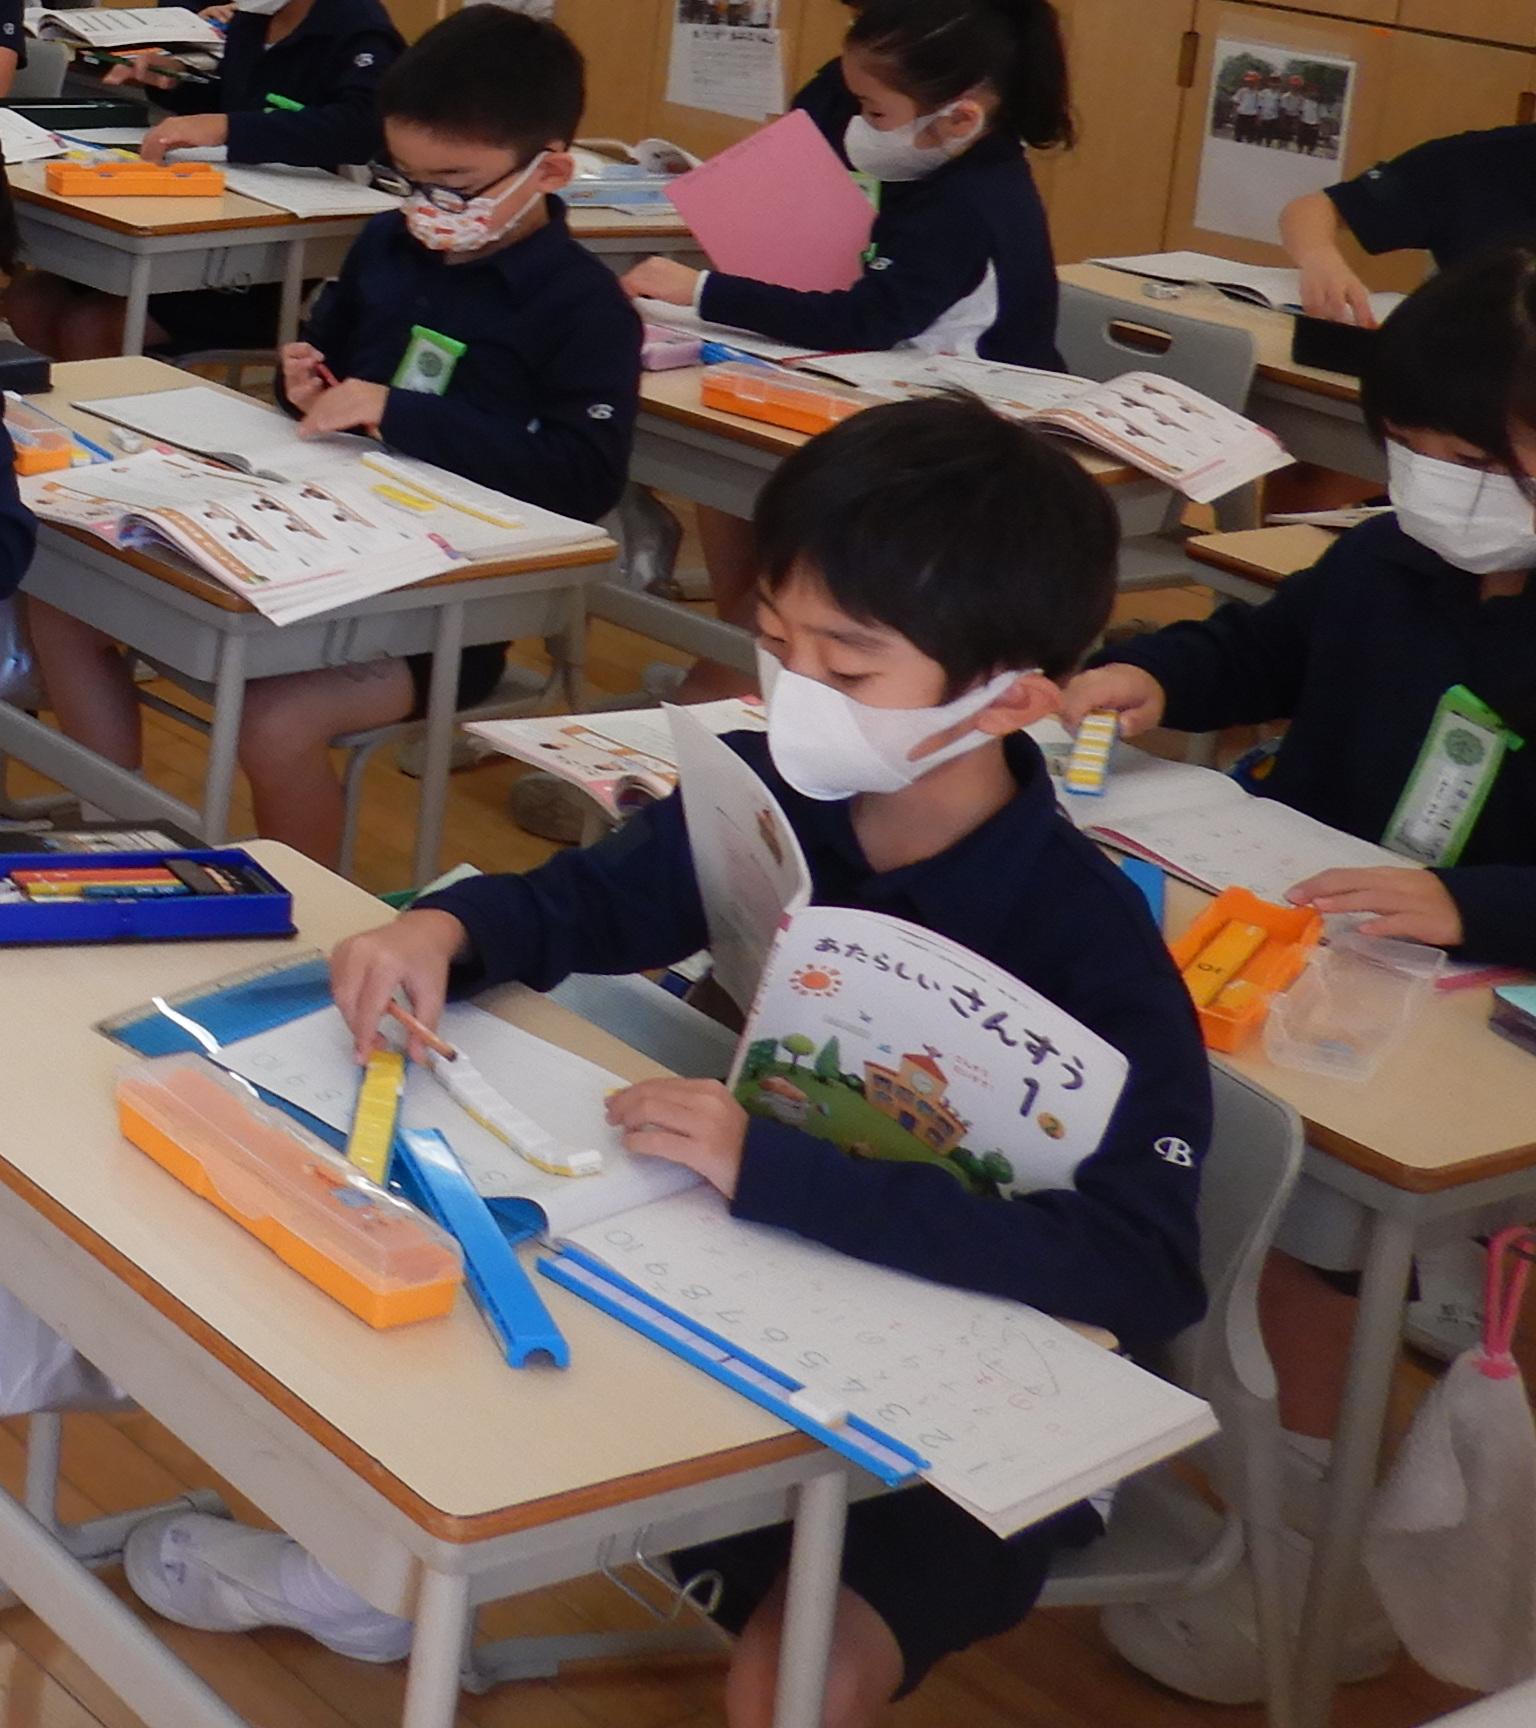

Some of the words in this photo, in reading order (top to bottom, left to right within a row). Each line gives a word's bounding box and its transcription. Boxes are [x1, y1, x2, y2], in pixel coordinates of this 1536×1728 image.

[814, 936, 940, 991] あたらしい
[949, 984, 1084, 1091] さんすう
[1020, 1077, 1040, 1117] 1
